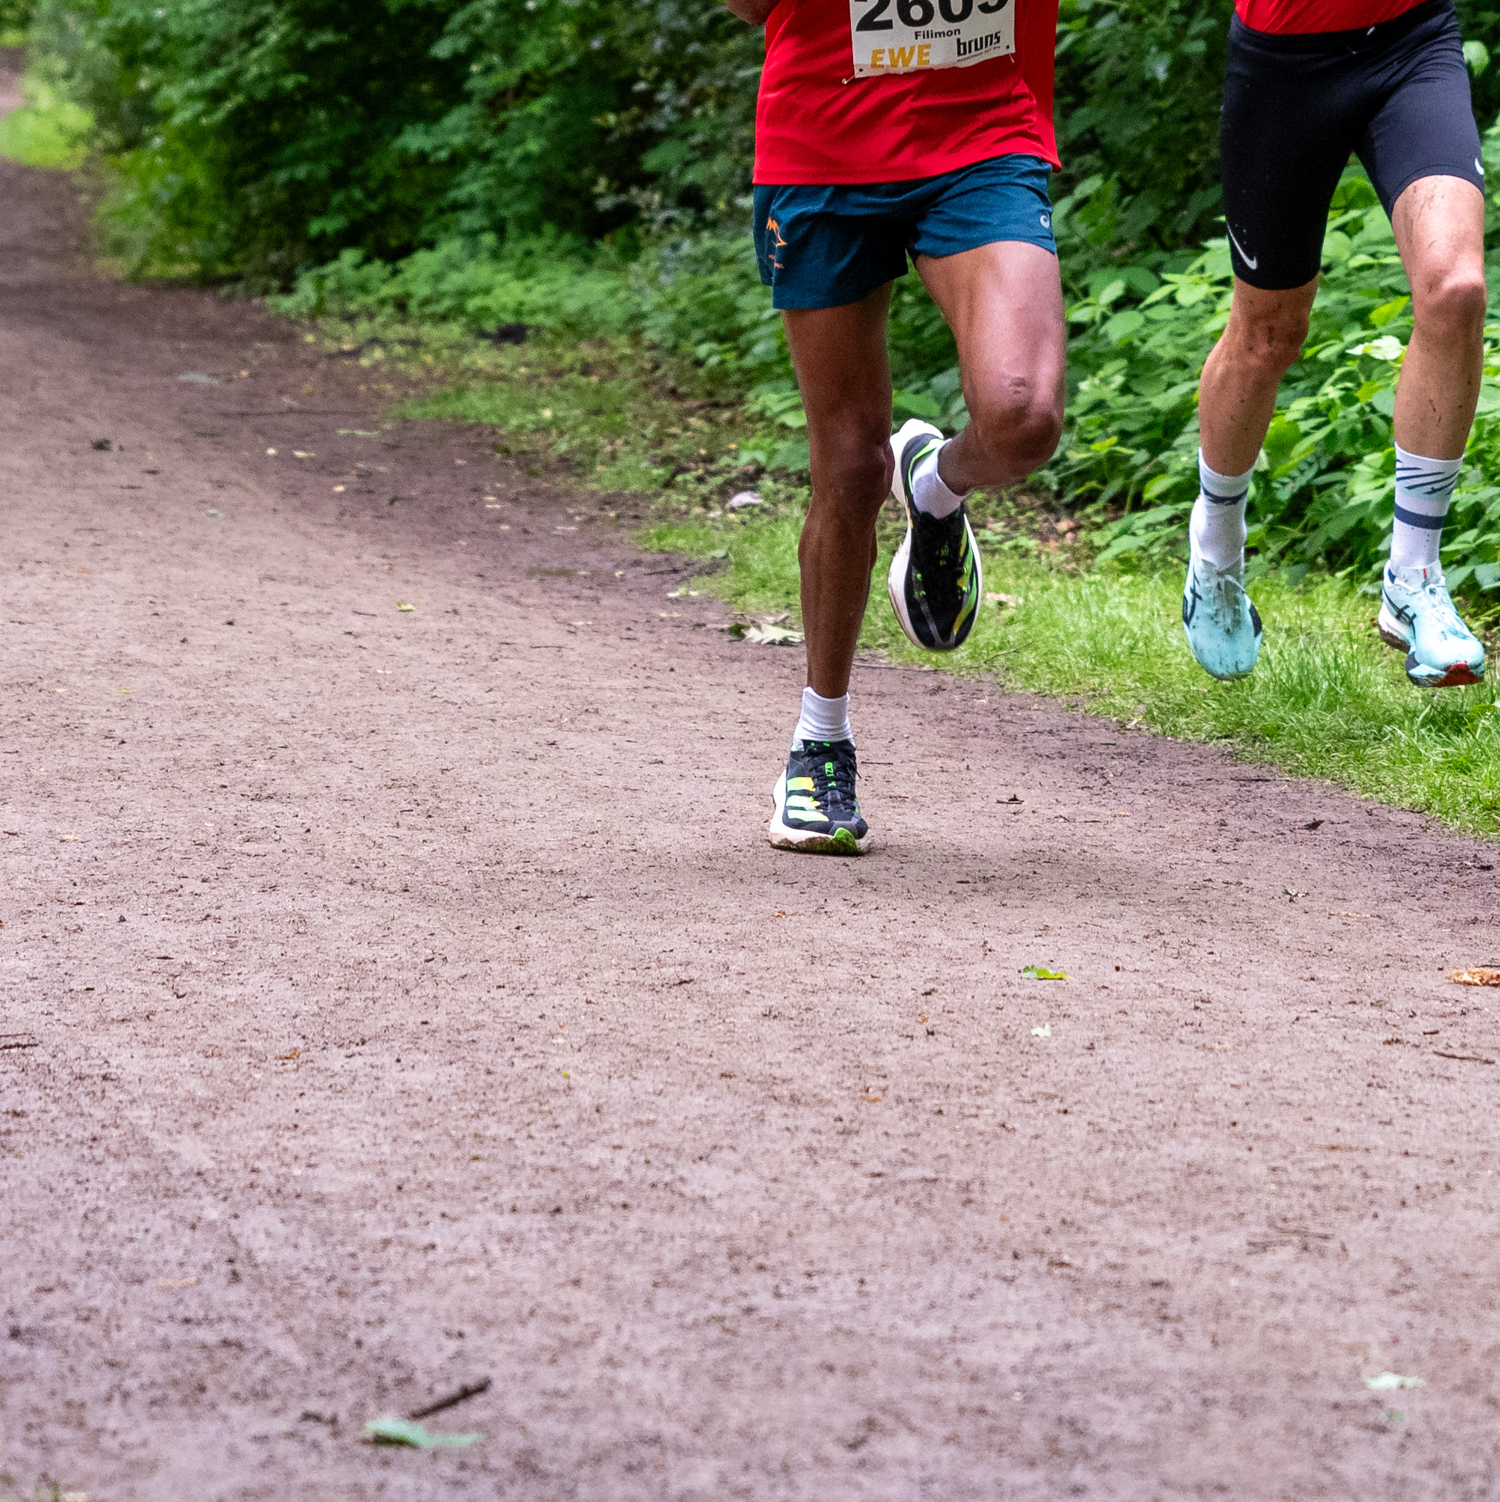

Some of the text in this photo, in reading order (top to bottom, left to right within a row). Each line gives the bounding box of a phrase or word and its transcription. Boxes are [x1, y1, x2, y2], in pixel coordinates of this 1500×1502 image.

[914, 28, 961, 40] Filimon
[956, 30, 1001, 57] bruns
[870, 43, 932, 69] EWE
